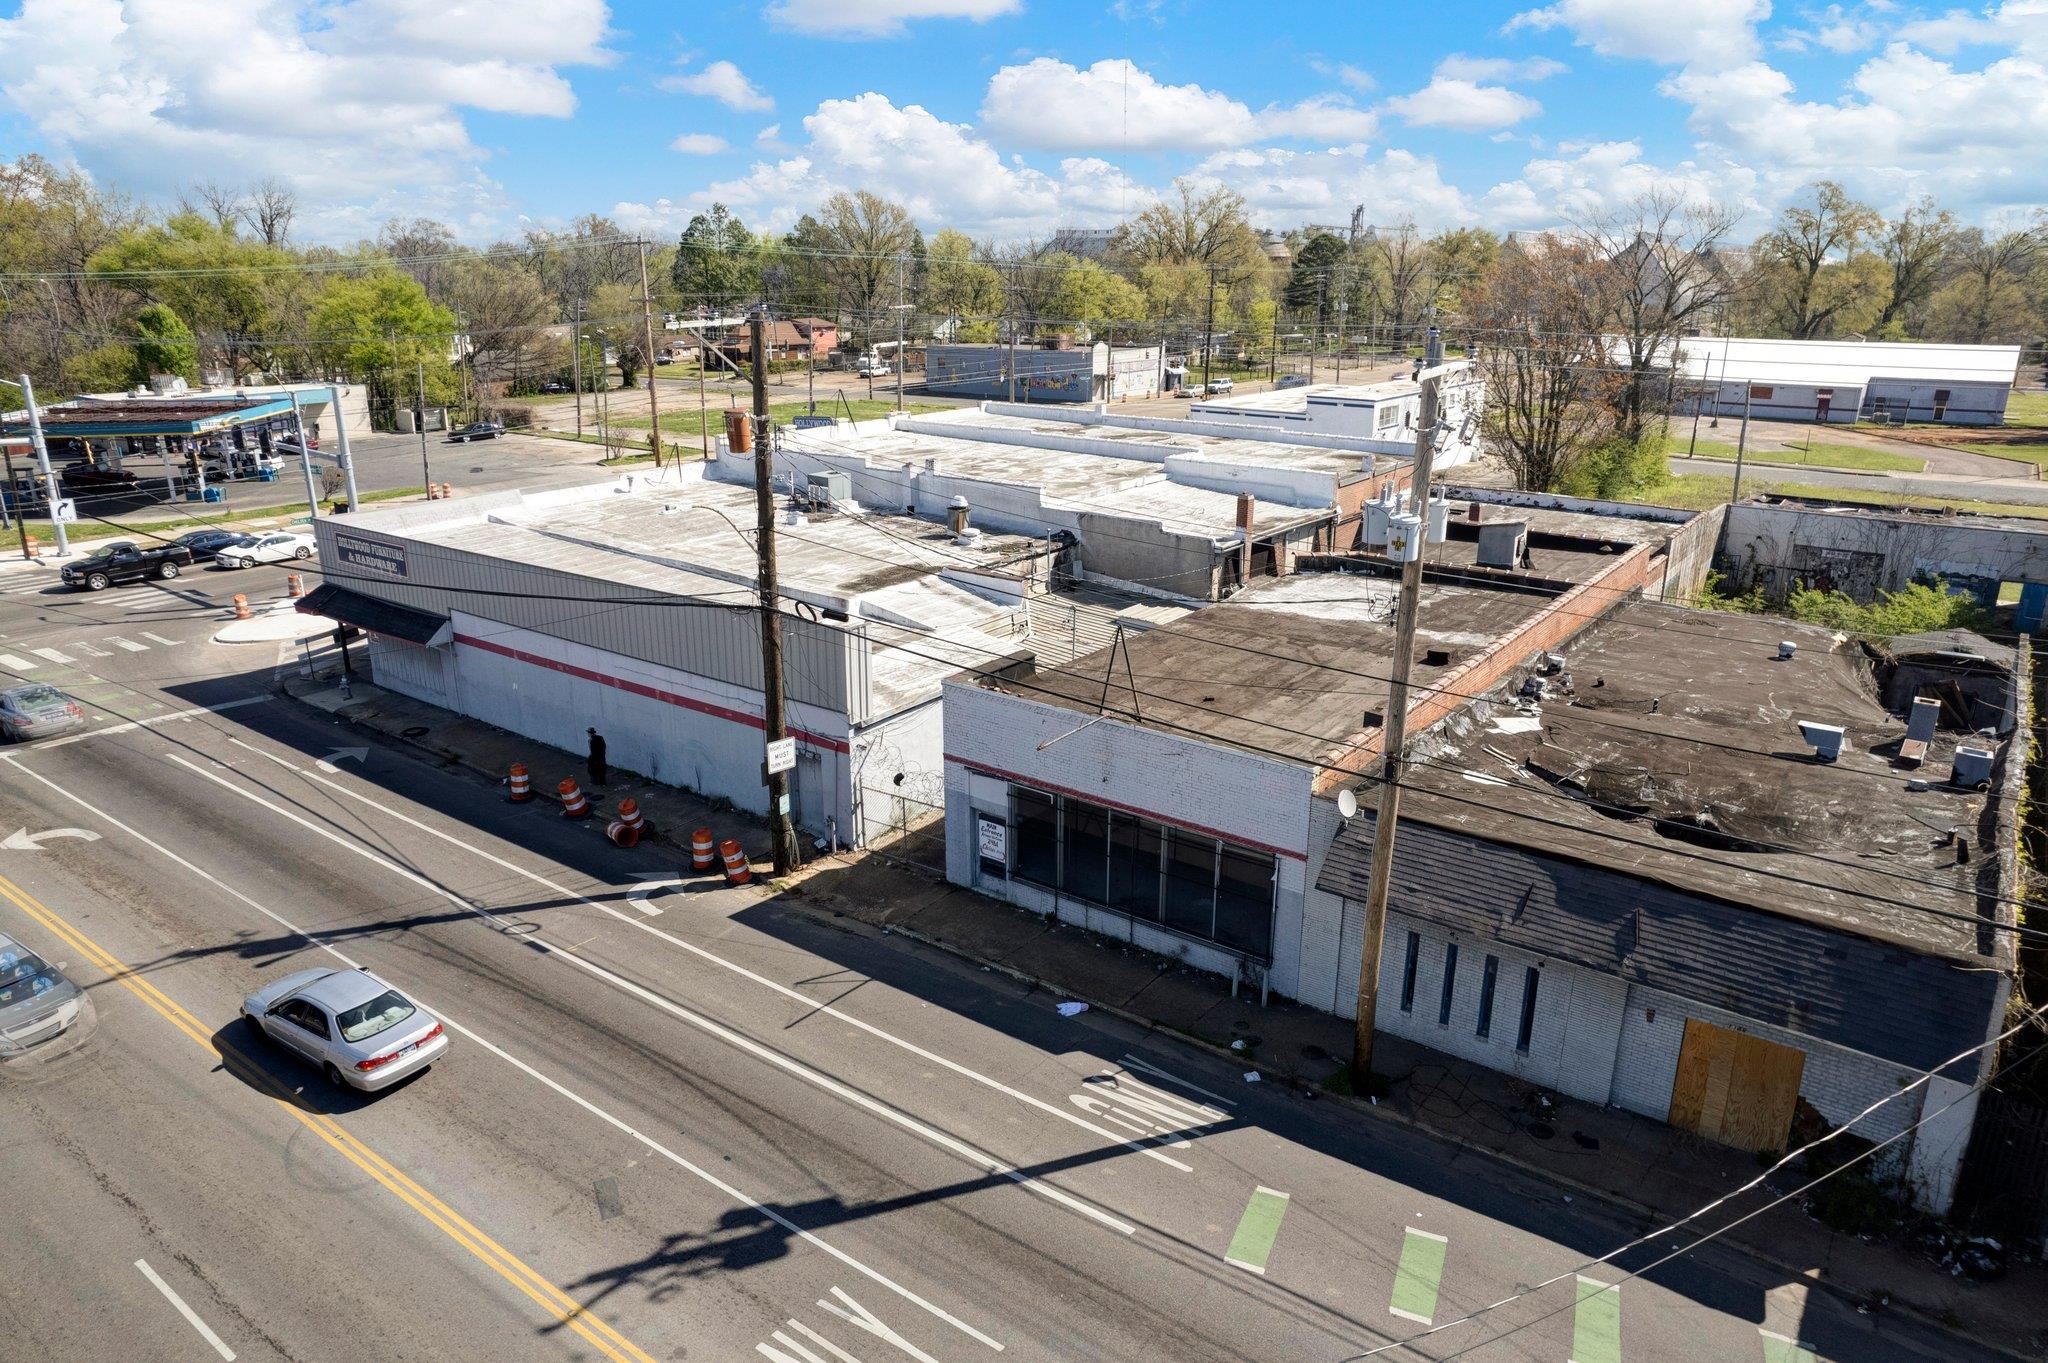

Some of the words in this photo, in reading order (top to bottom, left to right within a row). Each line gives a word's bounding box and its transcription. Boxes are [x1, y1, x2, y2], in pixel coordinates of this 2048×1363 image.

[795, 419, 831, 427] HOLLYWOOD
[337, 537, 370, 553] HOLLYWOOD
[371, 544, 404, 561] FURNITURE
[348, 552, 355, 562] &
[355, 553, 397, 572] HARDWARE
[769, 744, 781, 752] RIGHT
[774, 750, 789, 759] MUST
[770, 761, 781, 769] TURN
[782, 758, 794, 766] RIGHT
[980, 826, 1003, 838] Entrance
[1069, 1053, 1238, 1149] ONLY
